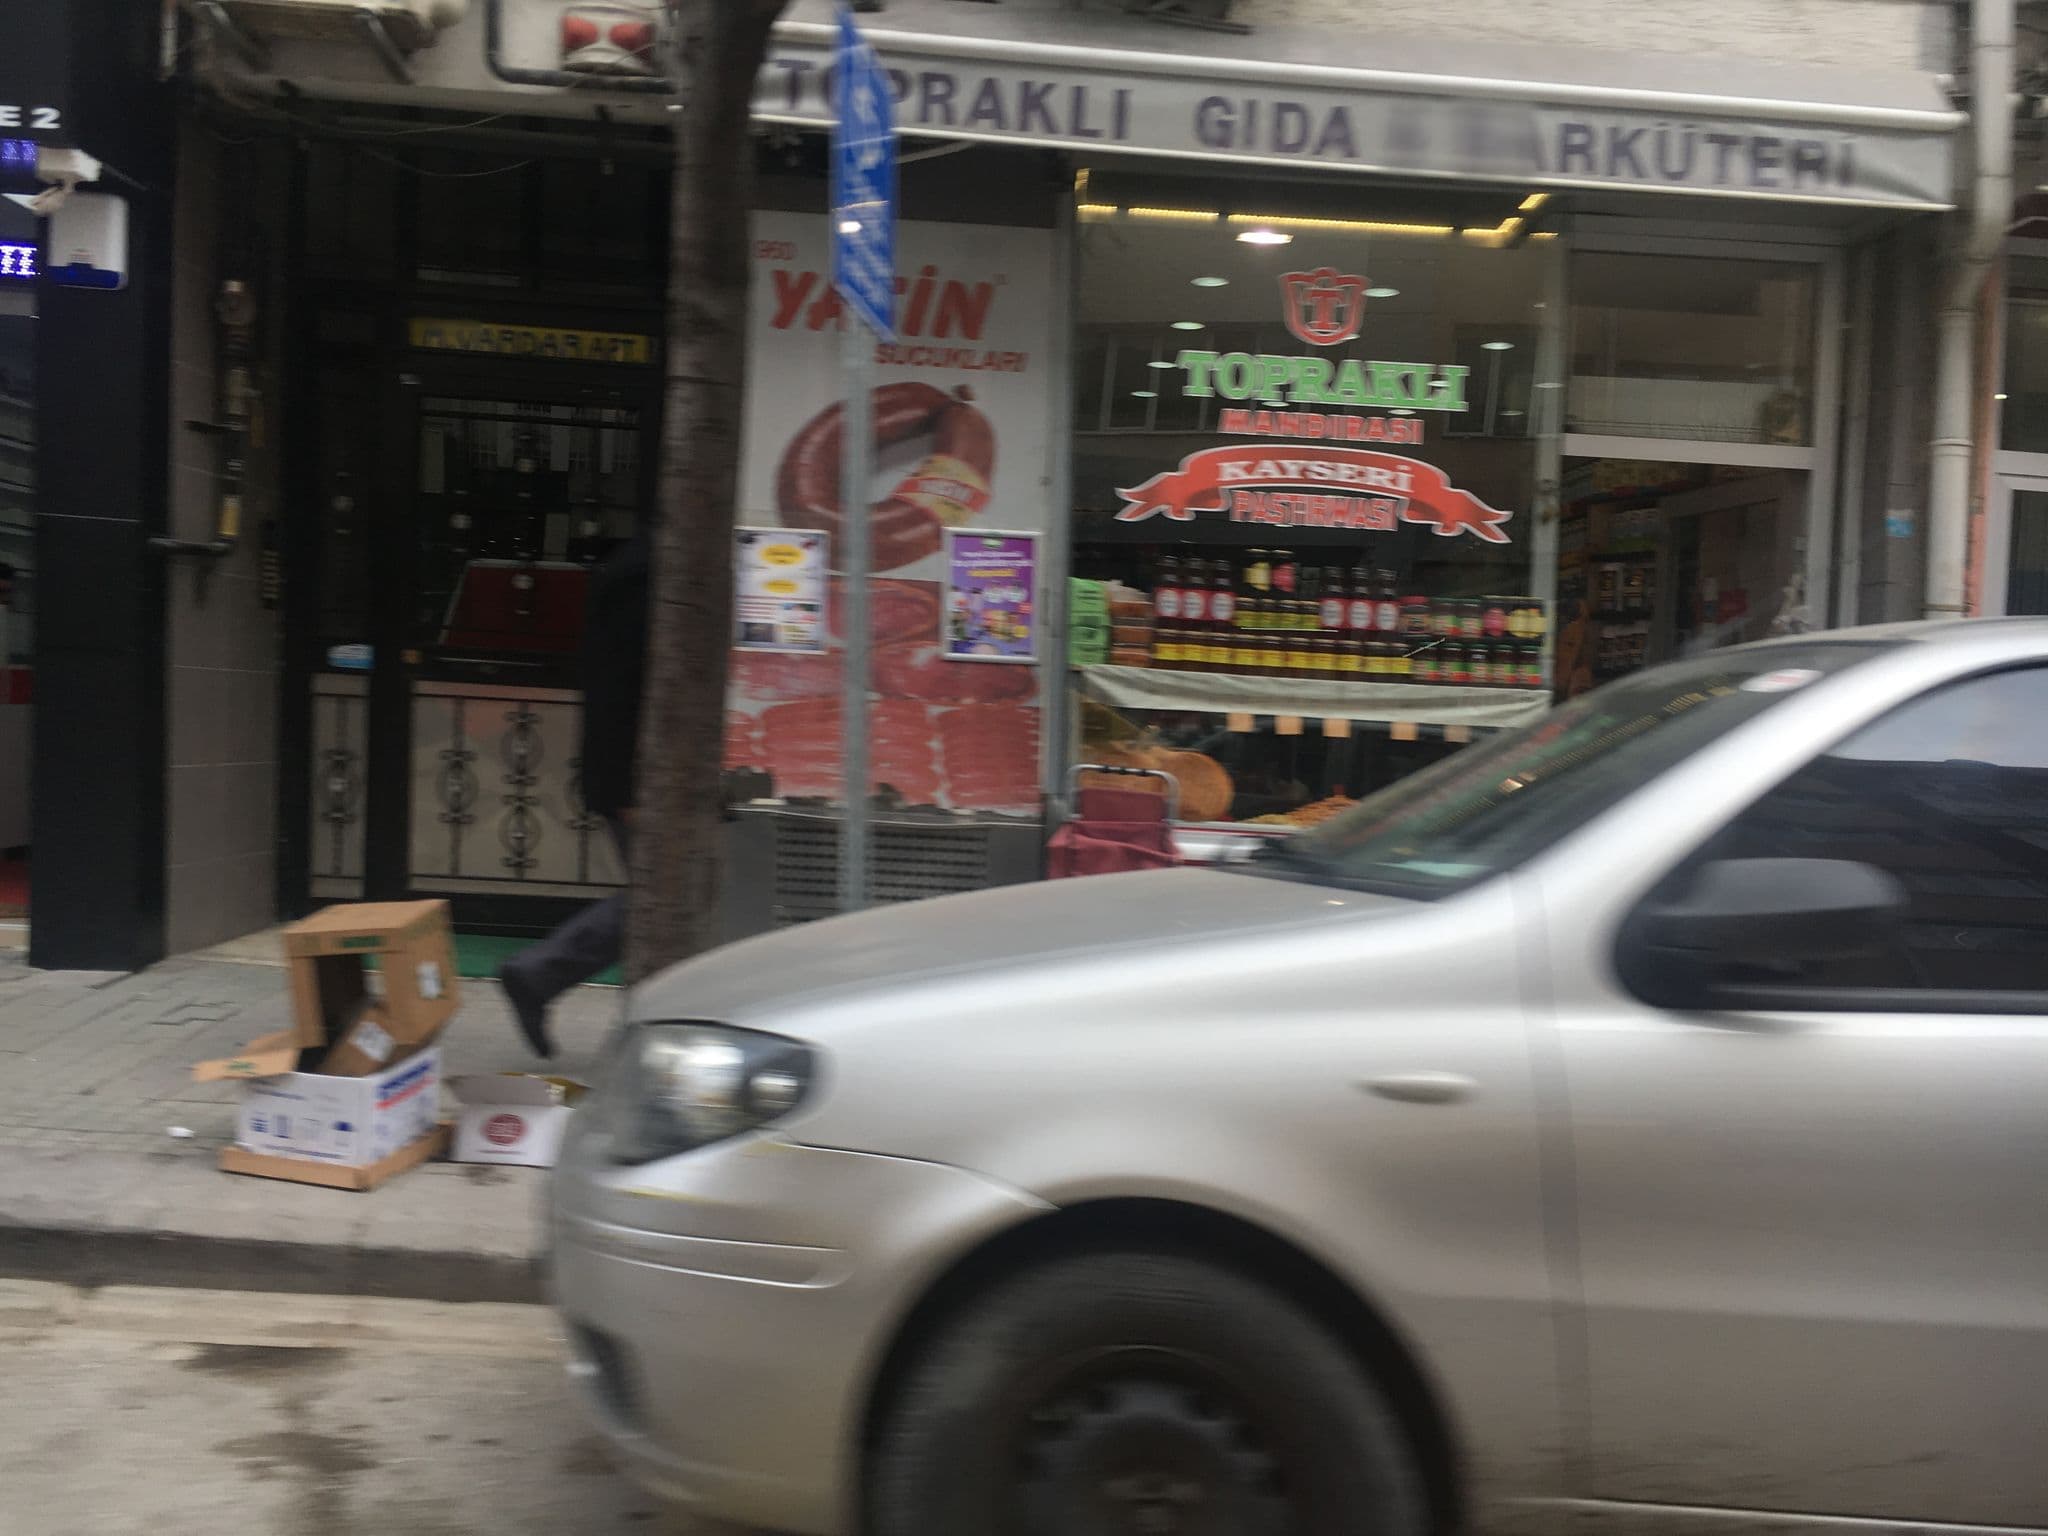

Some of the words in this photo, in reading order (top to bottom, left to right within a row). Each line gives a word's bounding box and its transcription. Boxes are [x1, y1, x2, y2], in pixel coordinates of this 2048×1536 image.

[30, 107, 61, 129] 2
[1194, 95, 1360, 158] GIDA
[769, 264, 994, 341] YAİN
[1176, 350, 1471, 412] TOPRAKLI
[1217, 408, 1424, 446] MANDIRASI
[1216, 459, 1416, 492] KAYSERİ
[1229, 490, 1398, 531] PASTIRMASI
